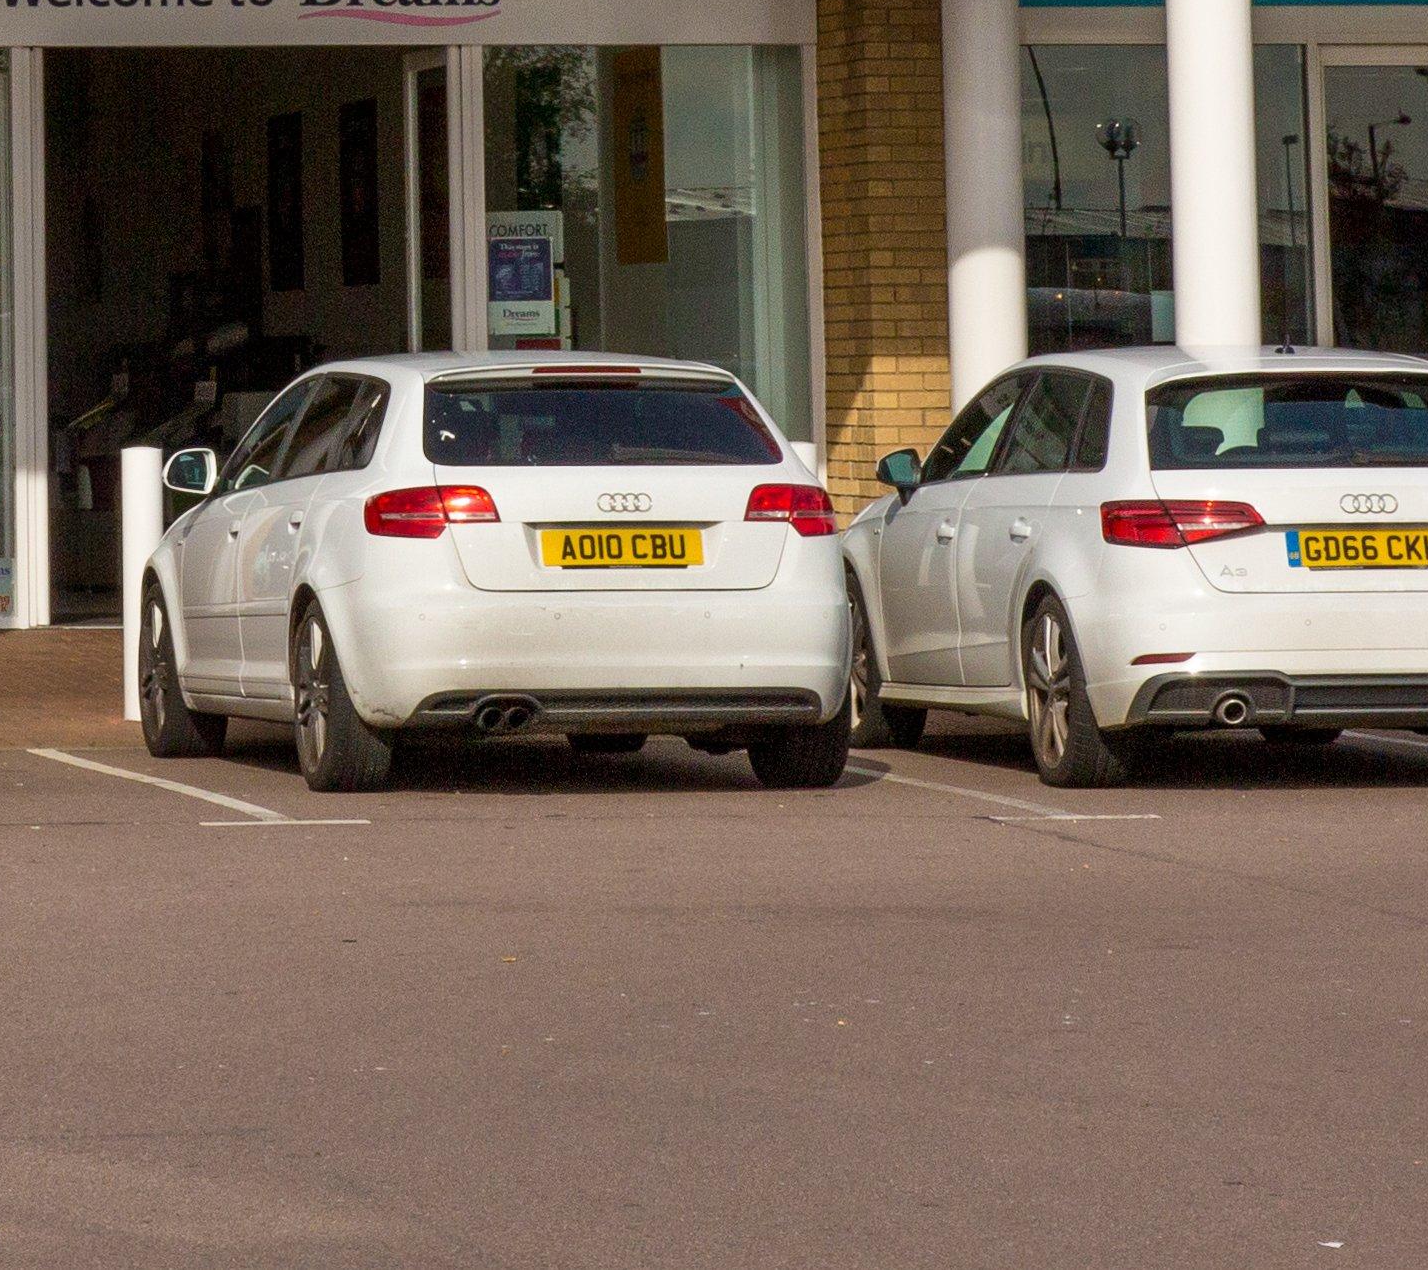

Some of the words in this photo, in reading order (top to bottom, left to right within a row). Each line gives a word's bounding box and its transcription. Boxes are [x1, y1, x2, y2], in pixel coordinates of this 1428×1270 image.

[489, 223, 548, 237] COMFORT
[502, 308, 541, 319] Dreams
[631, 533, 686, 560] CBU
[1304, 535, 1379, 562] GD66
[1219, 563, 1248, 578] A3
